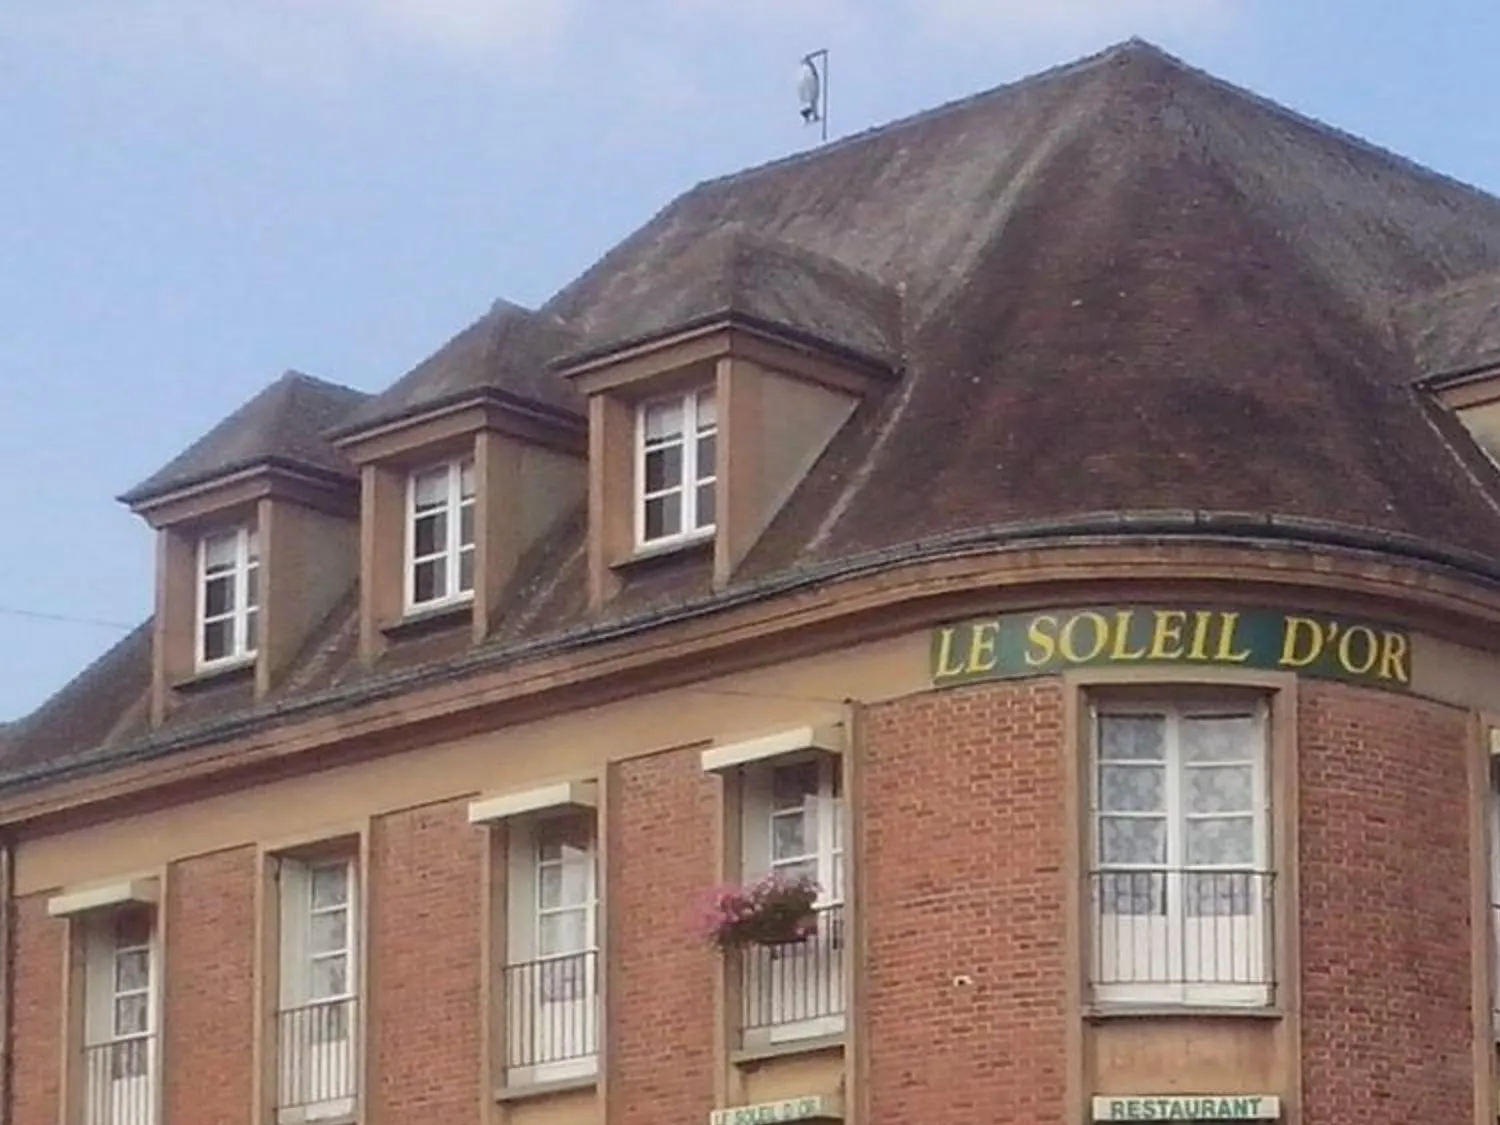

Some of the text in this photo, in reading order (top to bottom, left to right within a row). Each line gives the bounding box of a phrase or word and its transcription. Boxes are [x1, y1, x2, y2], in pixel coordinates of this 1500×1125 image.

[935, 610, 1409, 683] LE SOLEIL D'OR
[1110, 1098, 1262, 1120] RESTAURANT
